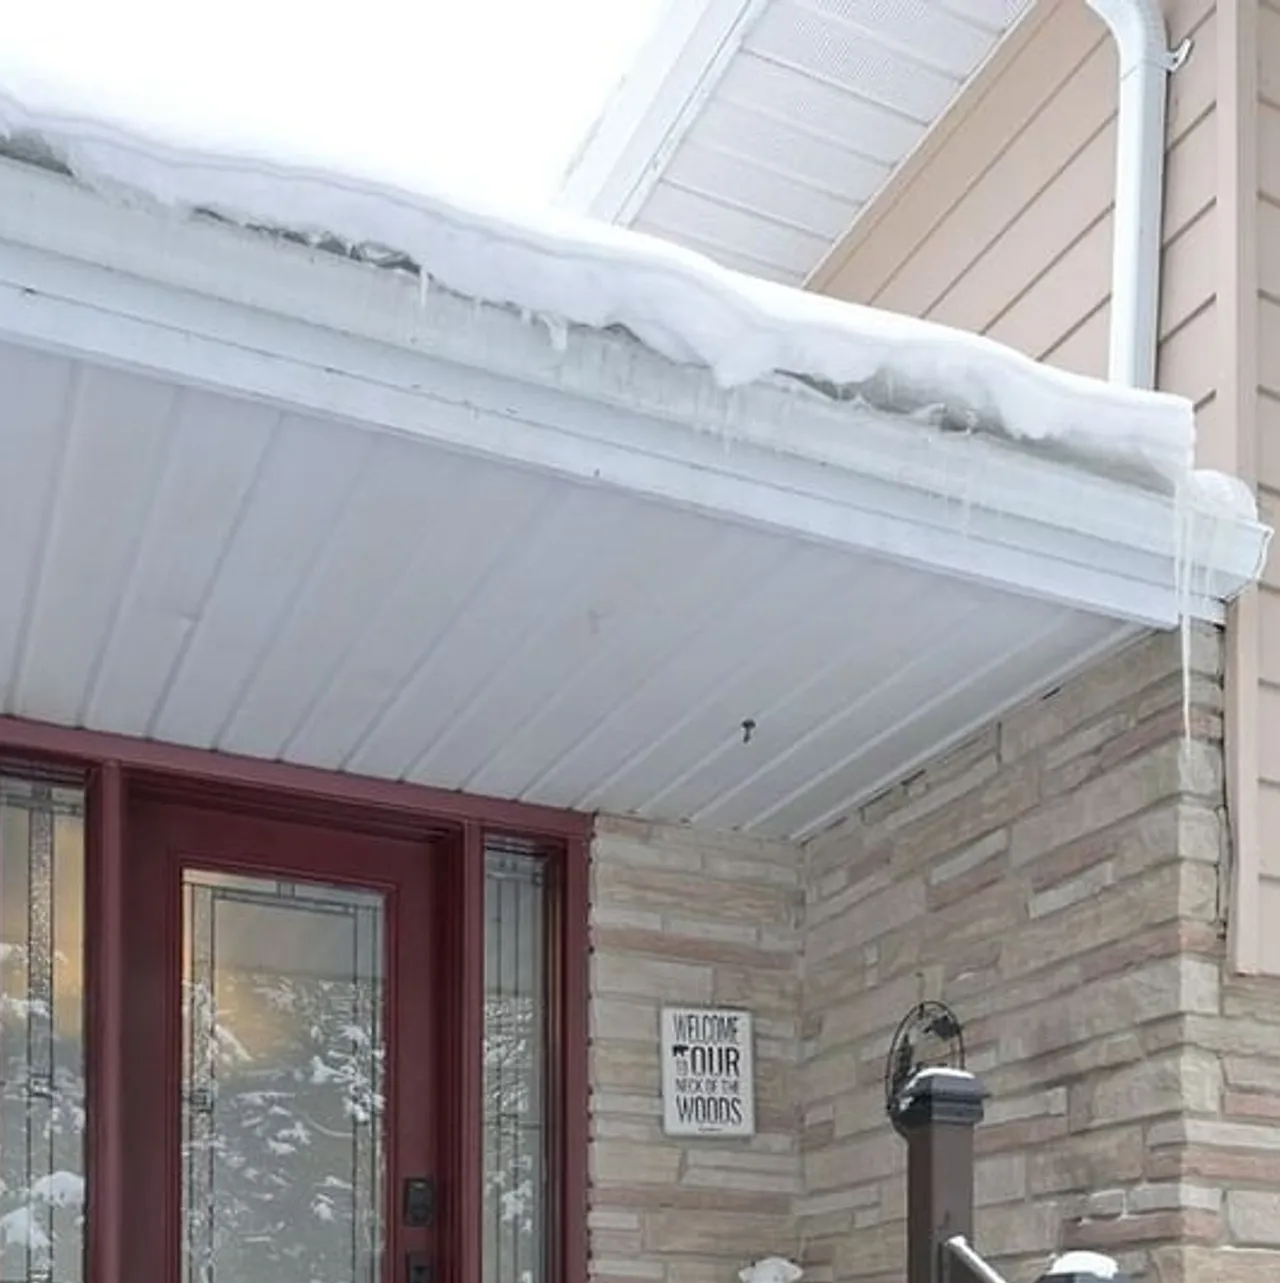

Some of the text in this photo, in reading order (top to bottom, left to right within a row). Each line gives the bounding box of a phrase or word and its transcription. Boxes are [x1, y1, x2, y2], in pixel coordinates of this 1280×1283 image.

[673, 1013, 739, 1044] WELCOME
[690, 1046, 740, 1077] OUR
[675, 1095, 742, 1124] WOODS
